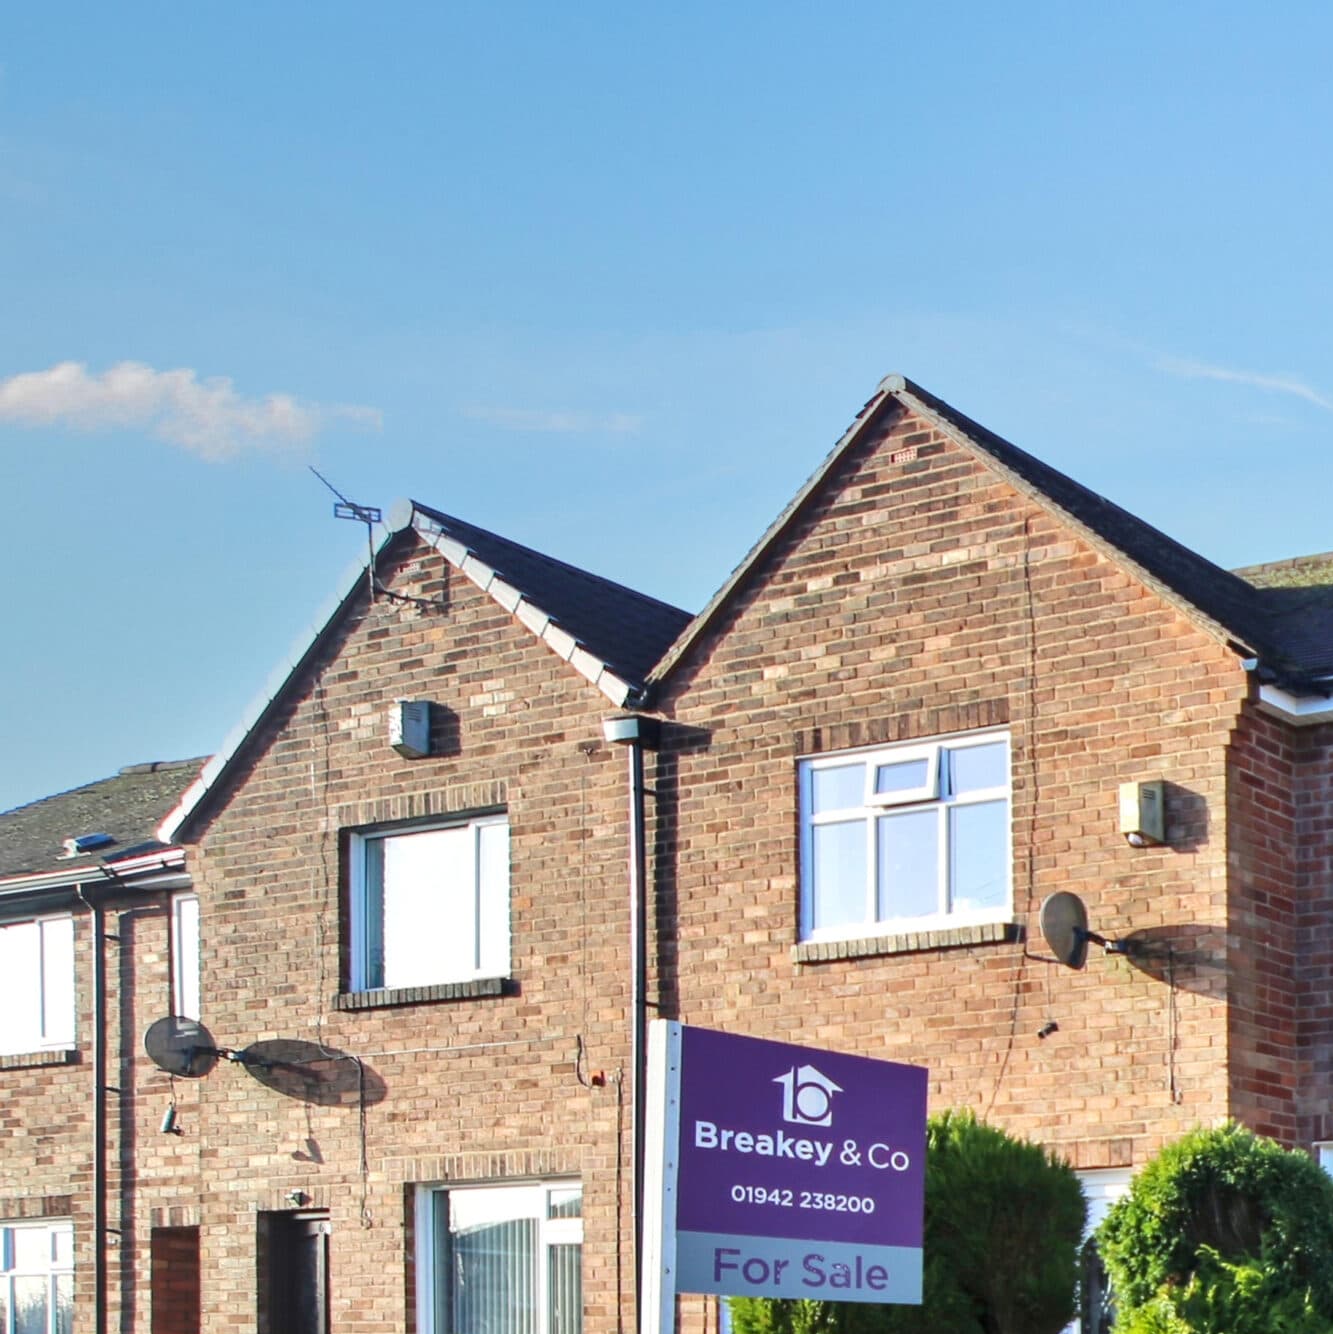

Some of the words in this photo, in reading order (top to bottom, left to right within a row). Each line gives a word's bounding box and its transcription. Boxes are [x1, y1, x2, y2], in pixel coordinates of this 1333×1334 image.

[694, 1120, 833, 1166] Breakey
[839, 1139, 862, 1166] &
[867, 1143, 910, 1171] Co
[731, 1185, 793, 1207] 01942
[799, 1192, 875, 1214] 238200
[713, 1248, 789, 1285] For
[801, 1254, 889, 1290] Sale
